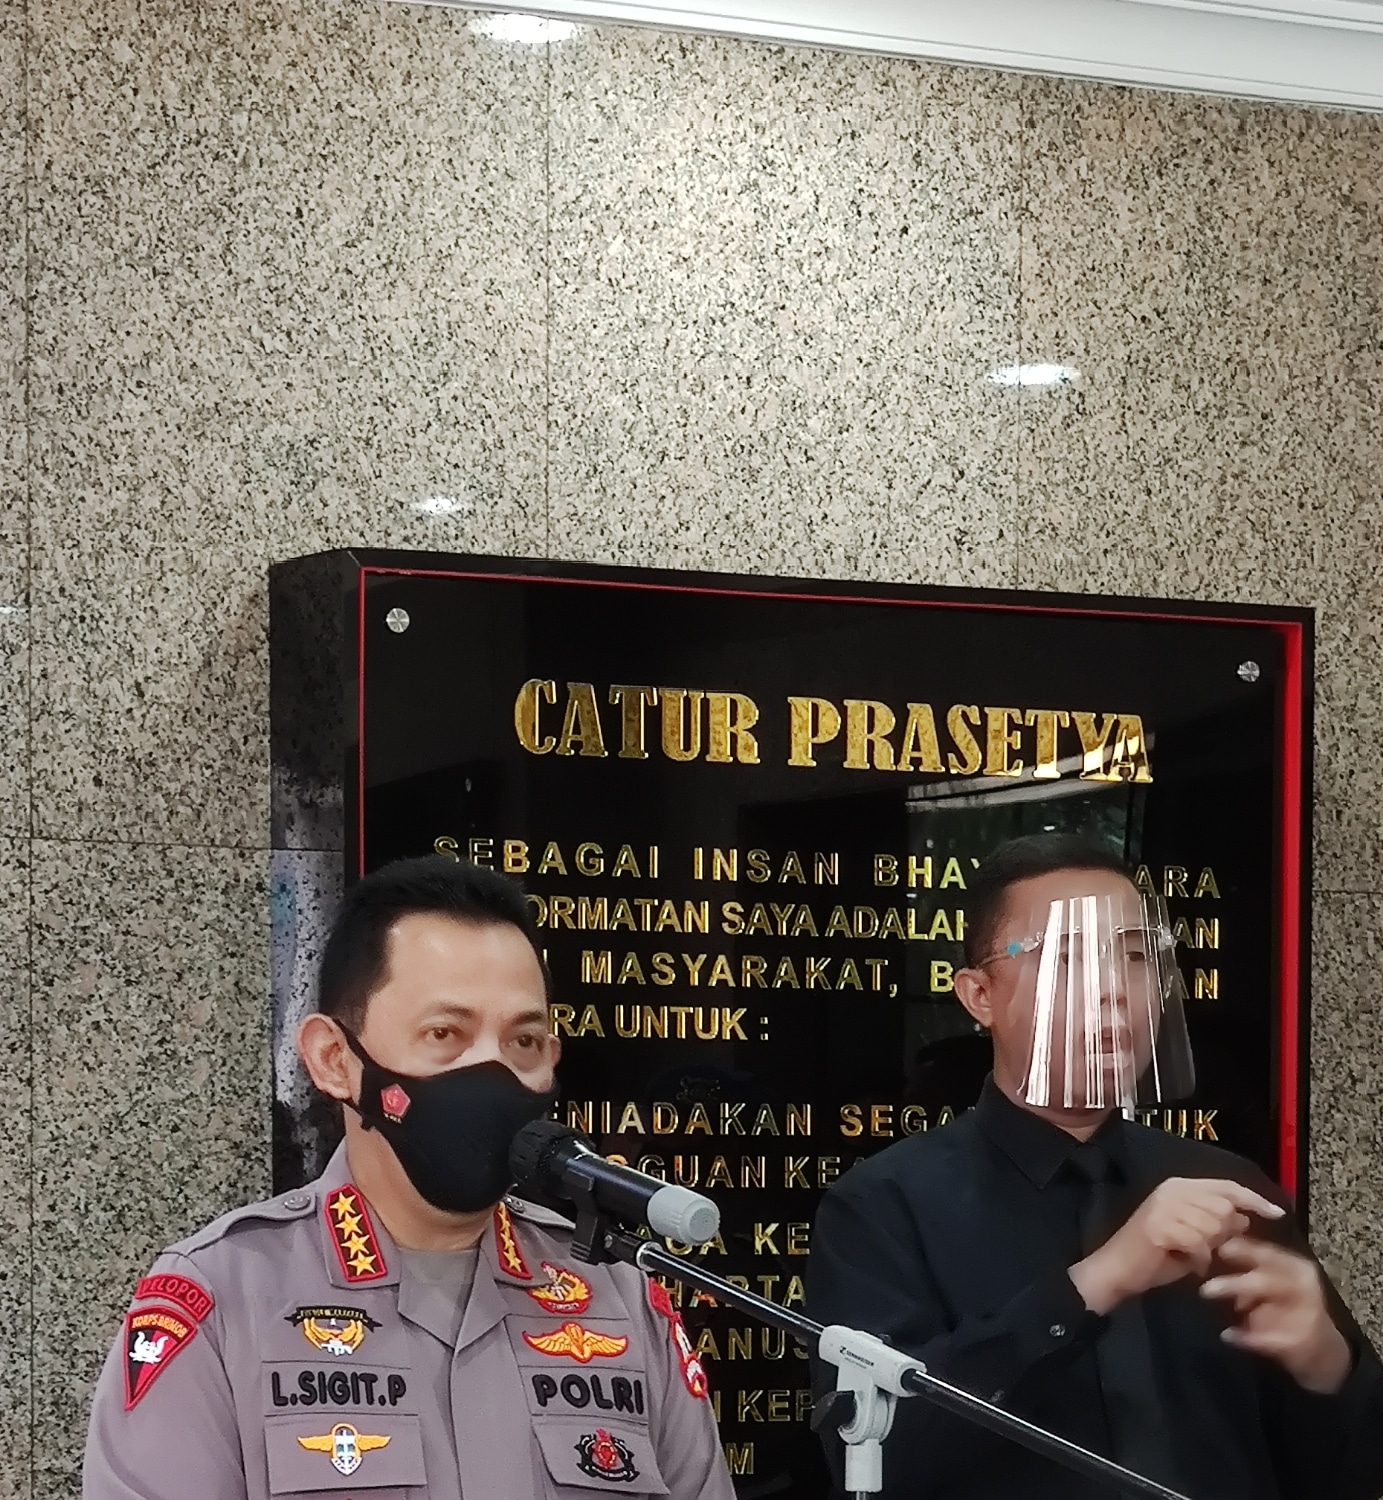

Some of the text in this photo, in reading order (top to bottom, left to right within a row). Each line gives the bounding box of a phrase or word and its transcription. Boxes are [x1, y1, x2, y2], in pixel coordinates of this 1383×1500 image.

[514, 678, 1154, 783] CATUR PRASETYA
[434, 836, 659, 879] SEBAGAI
[694, 847, 839, 885] INSAN
[874, 854, 980, 890] BHA
[721, 901, 819, 937] SAYA
[581, 950, 898, 998] MASYARAKAT,
[615, 1004, 748, 1041] UNTUK
[839, 1103, 976, 1137] SEGA
[606, 1154, 866, 1189] GUAN KE
[531, 1374, 645, 1415] POLRI
